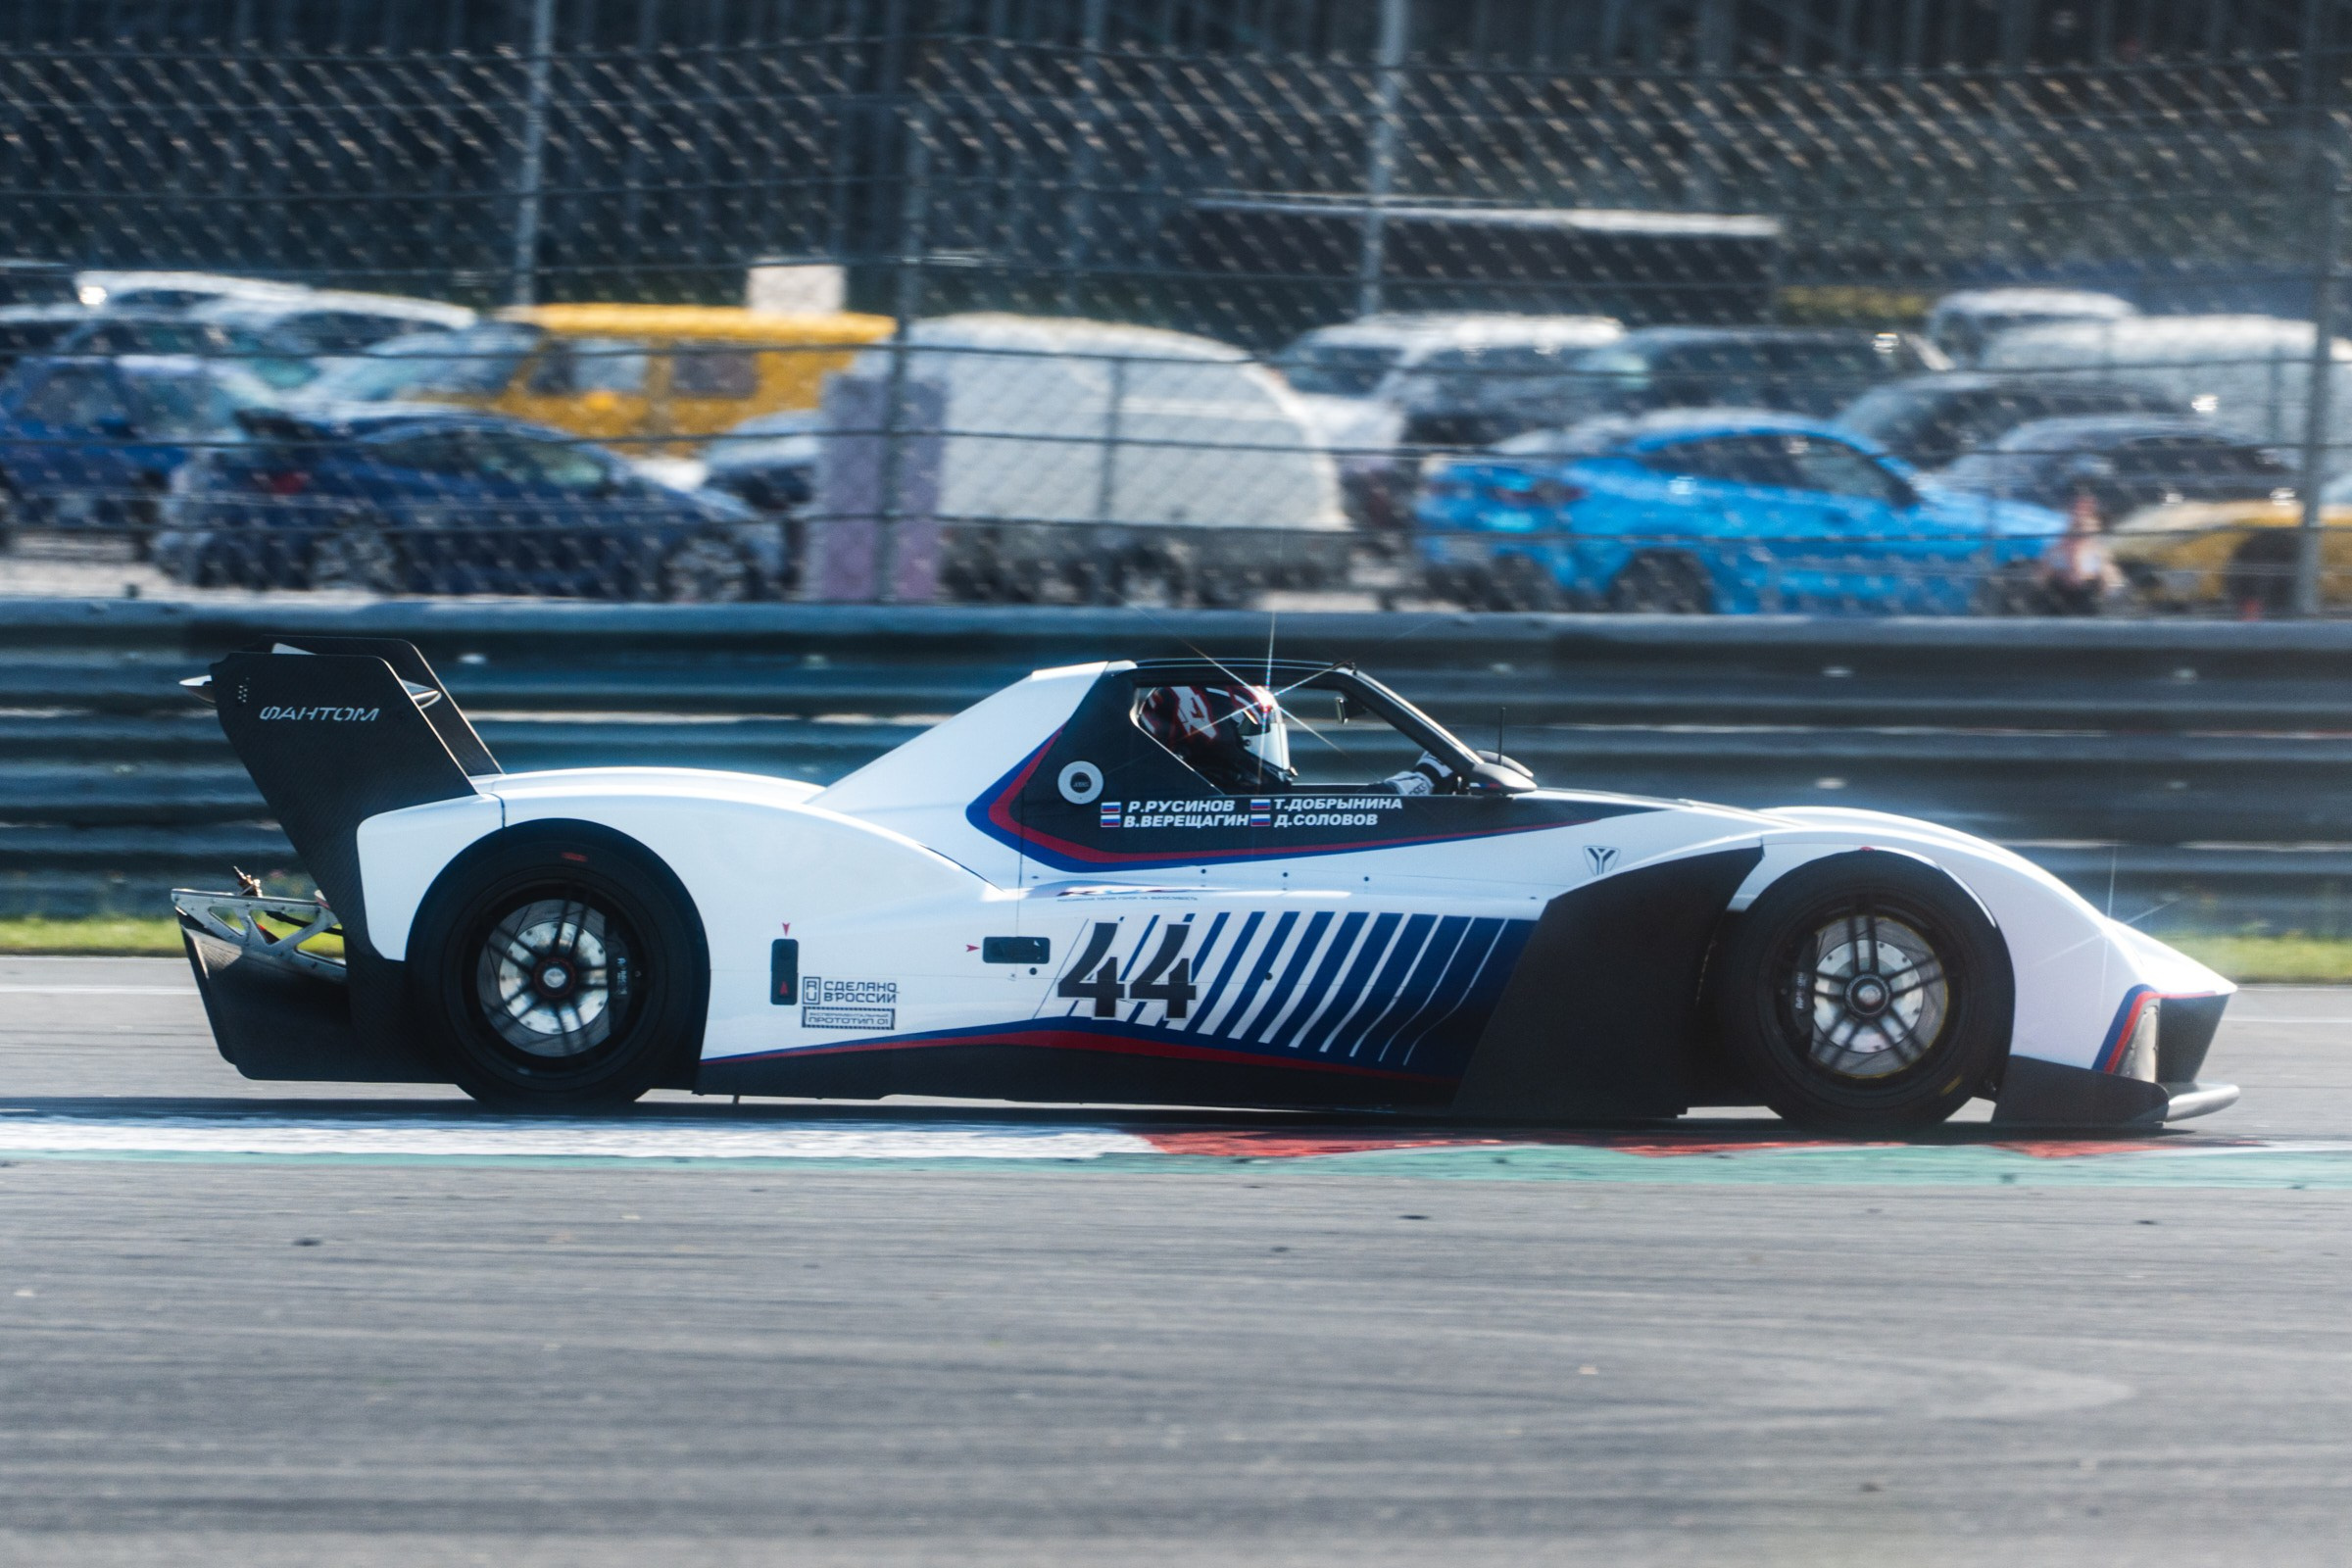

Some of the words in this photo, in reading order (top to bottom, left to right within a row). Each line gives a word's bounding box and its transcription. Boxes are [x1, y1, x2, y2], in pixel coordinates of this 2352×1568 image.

[259, 706, 380, 721] ФАНТОМ
[1127, 800, 1235, 813] Р.РУСИНОВ
[1274, 798, 1403, 812] Т.ДОБРЫНИНА
[1123, 814, 1250, 829] В.ВЕРЕЩАГИН
[1274, 813, 1378, 828] Д.СОЛОВОВ
[1056, 922, 1198, 1019] 44
[823, 981, 898, 993] СДЕЛАНО
[835, 992, 898, 1004] РОССИИ
[808, 1016, 875, 1025] ПРОТОТИП
